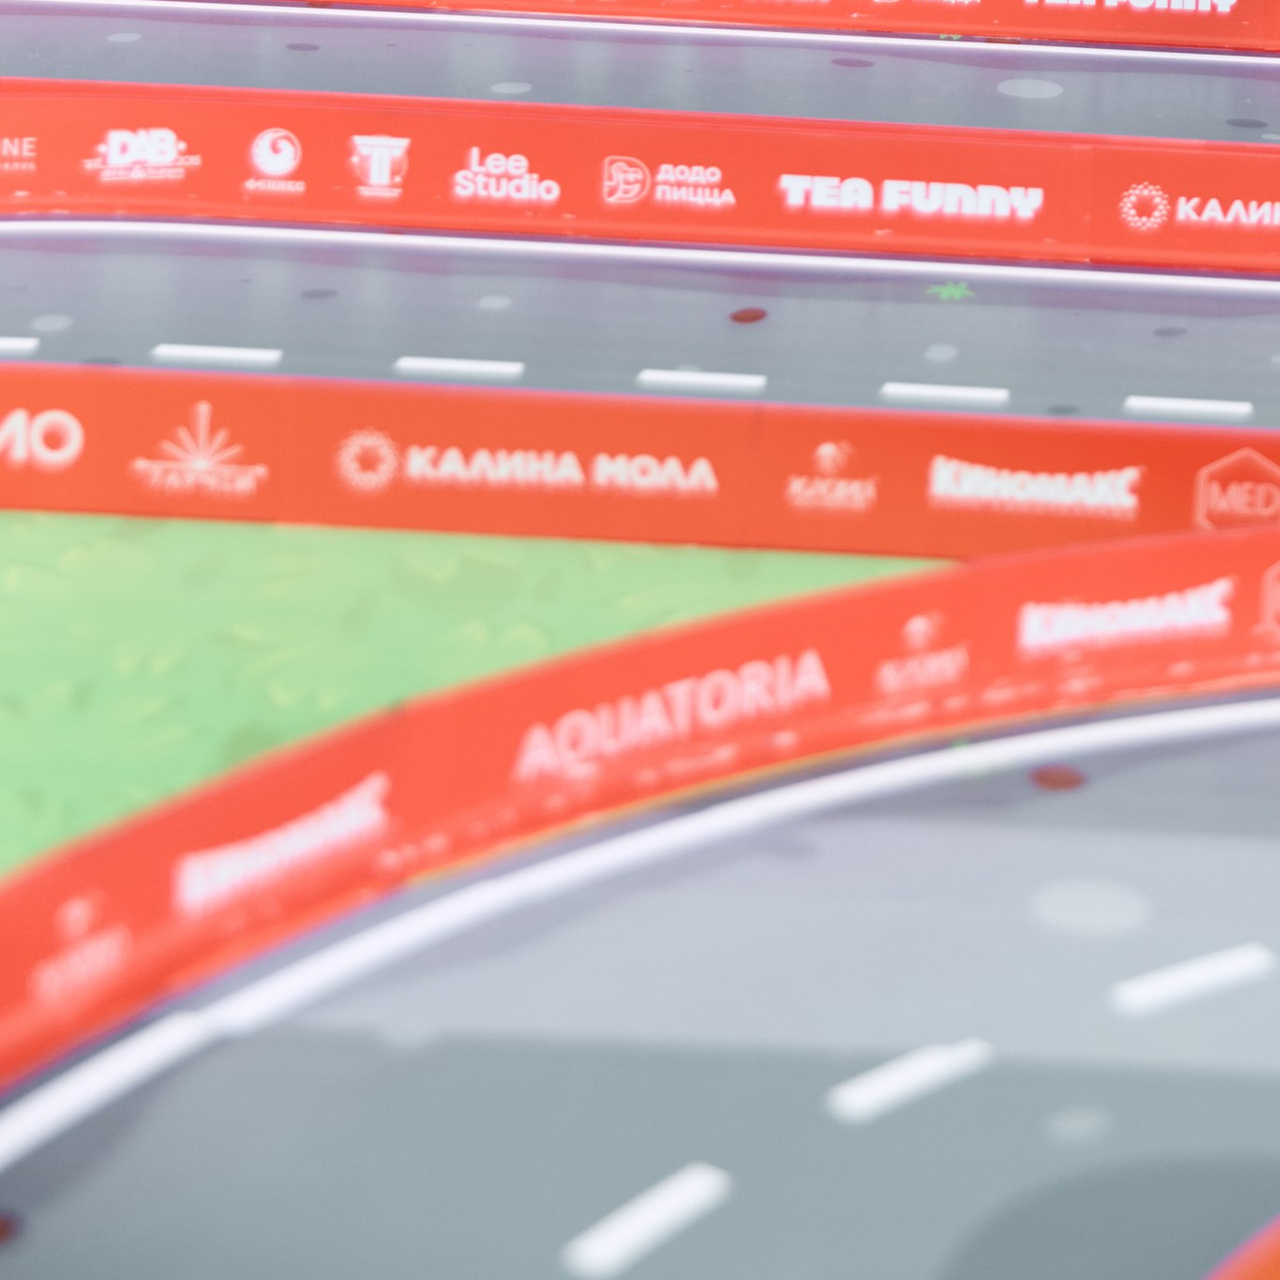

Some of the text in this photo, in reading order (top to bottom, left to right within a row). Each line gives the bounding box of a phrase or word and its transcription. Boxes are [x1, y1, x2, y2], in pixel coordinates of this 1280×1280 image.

[470, 146, 530, 175] Lee
[655, 163, 722, 184] ДОДО
[453, 171, 561, 203] Studio
[654, 184, 737, 208] ПИЦЦА
[778, 174, 1045, 220] TEA FUNNY
[404, 445, 719, 493] КАЛИНА МОЛЛ
[513, 646, 832, 783] AQUATORIA
